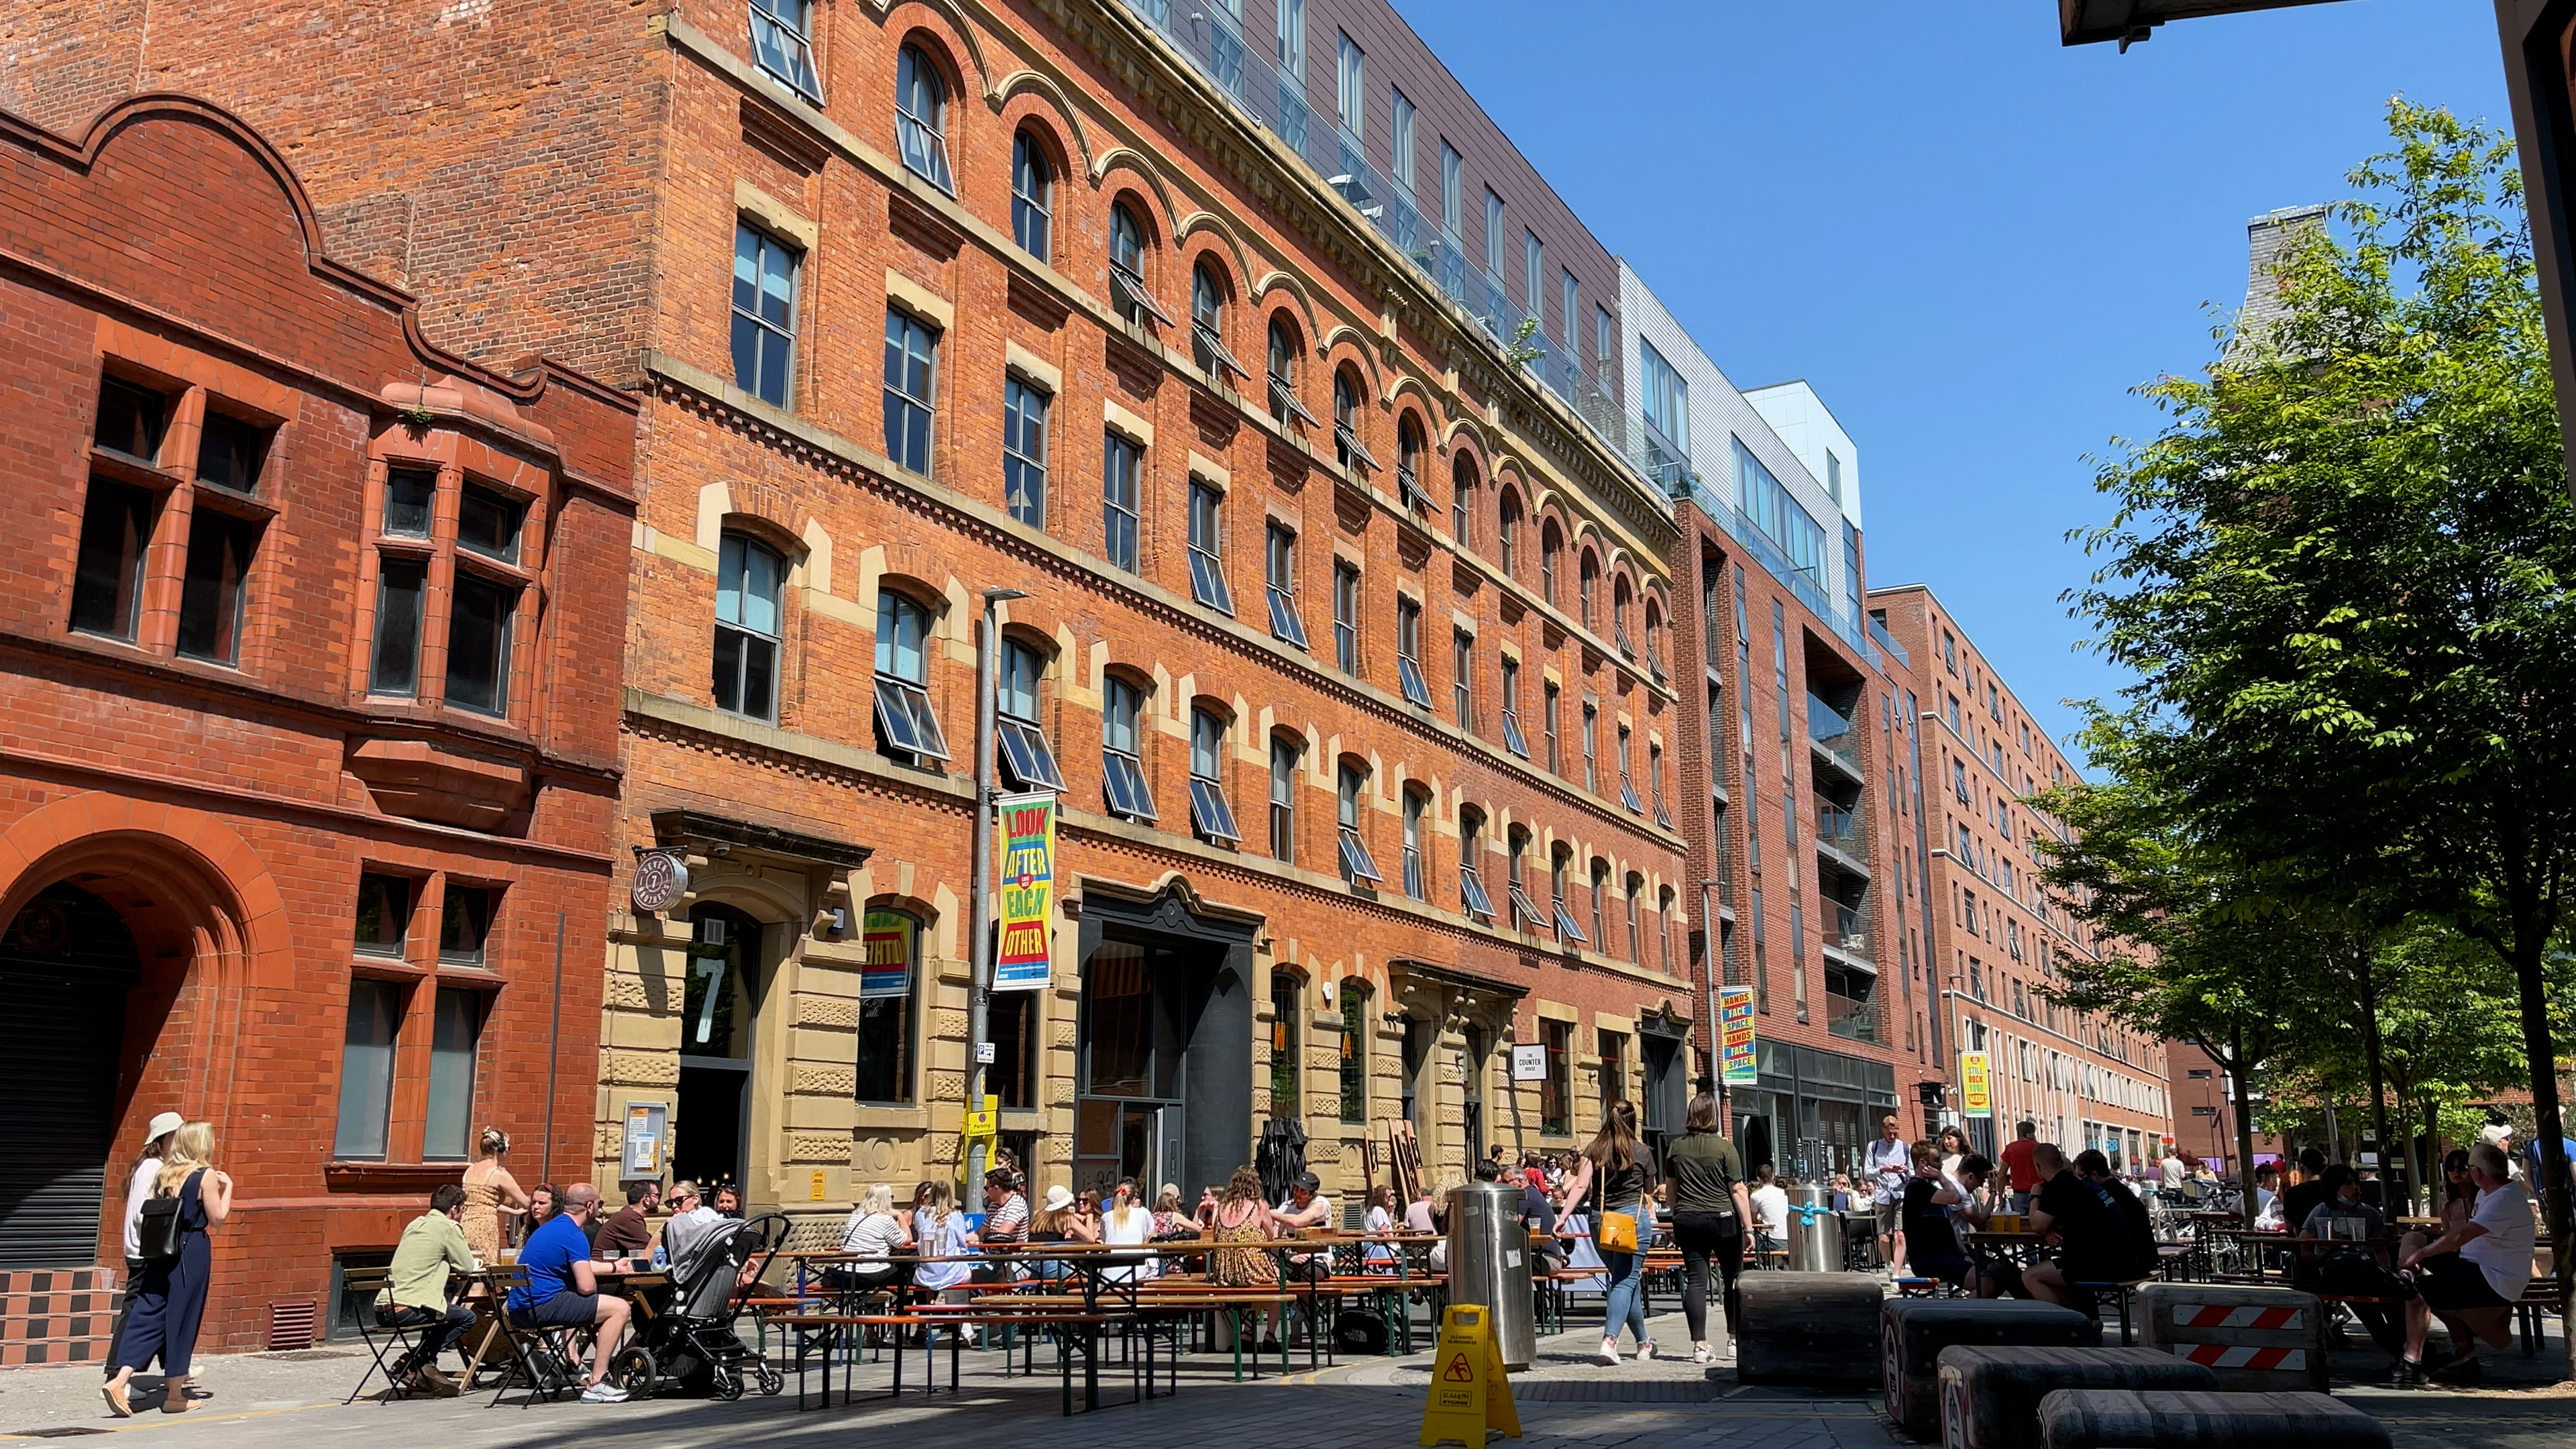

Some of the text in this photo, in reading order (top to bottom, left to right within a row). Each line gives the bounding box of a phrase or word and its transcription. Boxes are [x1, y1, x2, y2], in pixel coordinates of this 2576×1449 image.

[1006, 807, 1049, 838] LOOK
[643, 861, 667, 874] SEVEN
[1006, 847, 1047, 878] AFTER
[651, 875, 657, 888] 7
[637, 884, 669, 904] BROTHERS
[1006, 888, 1046, 918] EACH
[1005, 928, 1044, 957] OTHER
[696, 957, 725, 1043] 7
[1724, 993, 1749, 1006] HANDS
[1729, 1006, 1746, 1018] FACE
[1727, 1019, 1750, 1031] SPACE
[1726, 1031, 1751, 1044] HANDS
[1342, 1031, 1352, 1059] A
[1731, 1044, 1748, 1056] FACE
[1728, 1057, 1752, 1069] SPACE
[1968, 1067, 1982, 1075] STILL
[1968, 1075, 1983, 1083] ROCK
